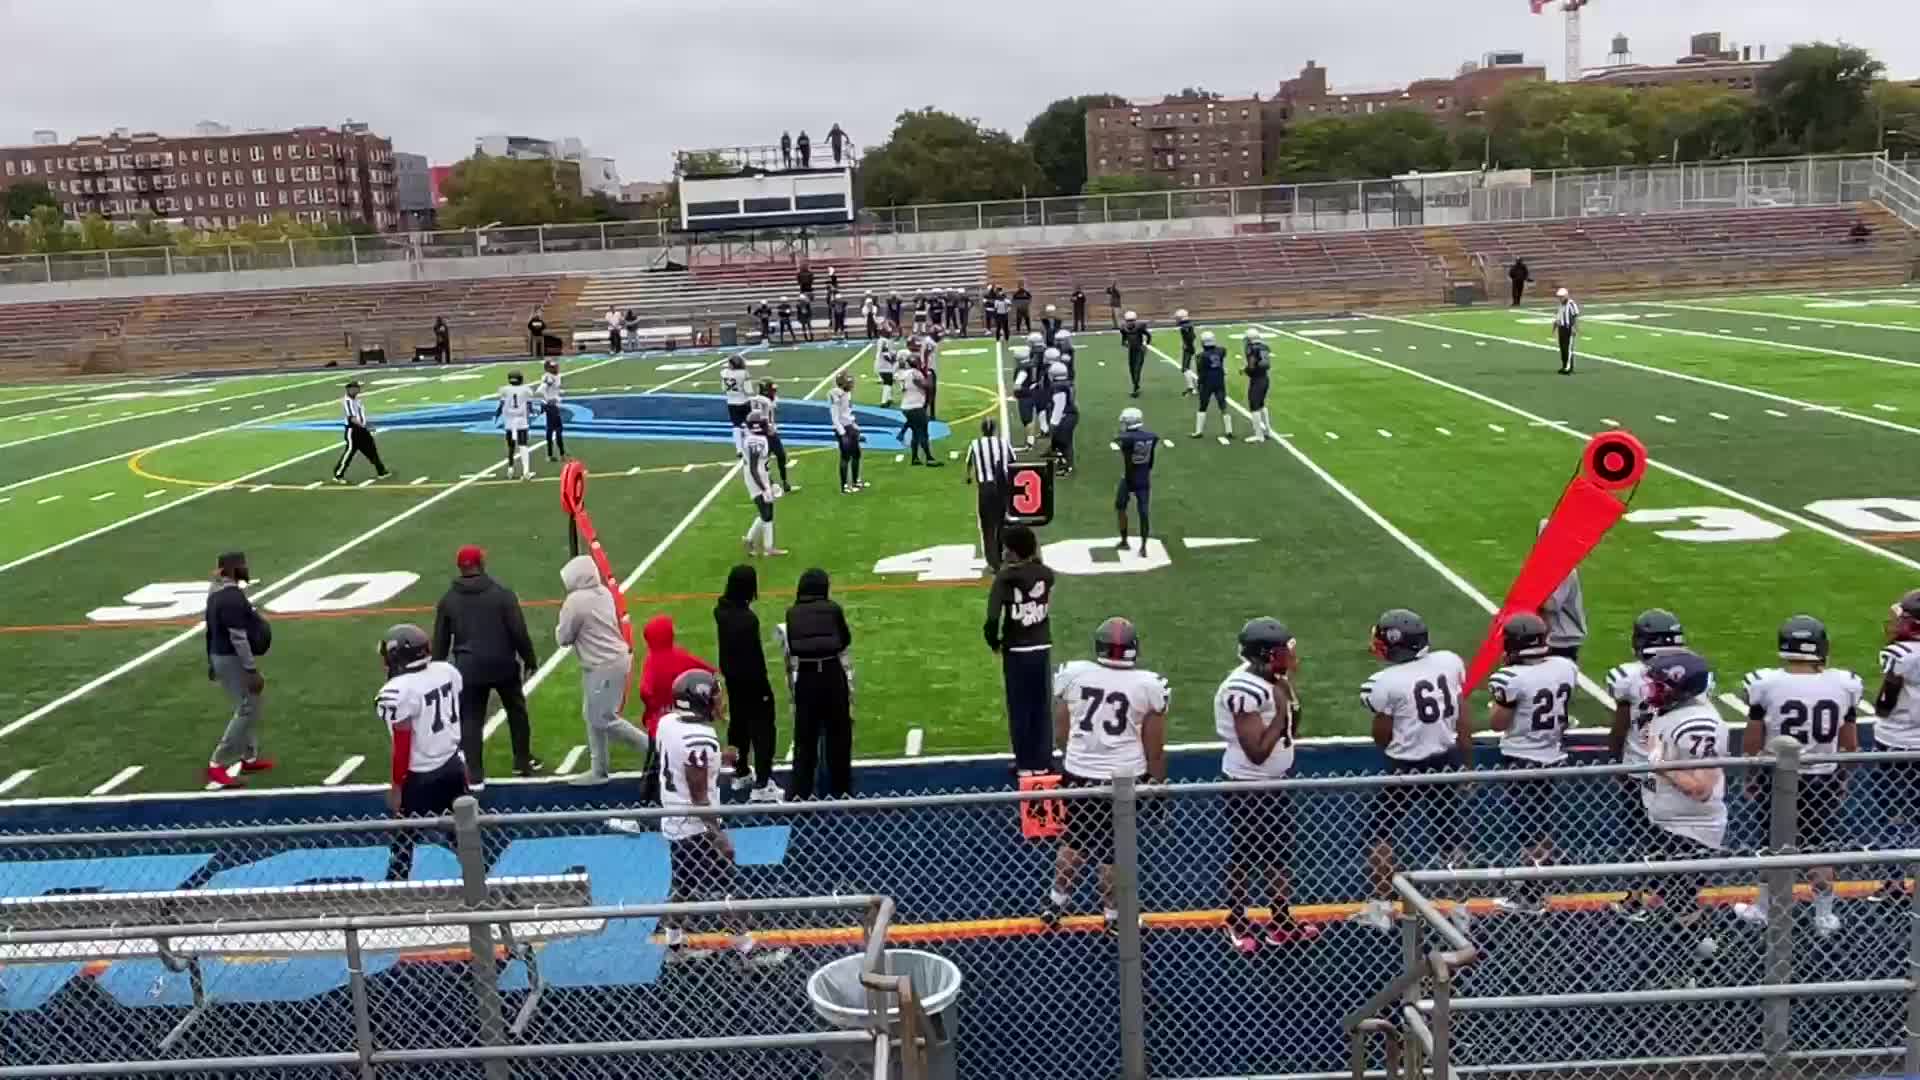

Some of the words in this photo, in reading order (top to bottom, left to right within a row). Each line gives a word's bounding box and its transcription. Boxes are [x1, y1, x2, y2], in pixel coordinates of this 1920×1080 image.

[513, 393, 519, 408] 1
[1012, 470, 1043, 514] 3
[424, 681, 458, 734] 77
[1079, 686, 1130, 736] 73
[1414, 674, 1455, 724] 61
[1531, 683, 1572, 731] 23
[1780, 699, 1840, 745] 20
